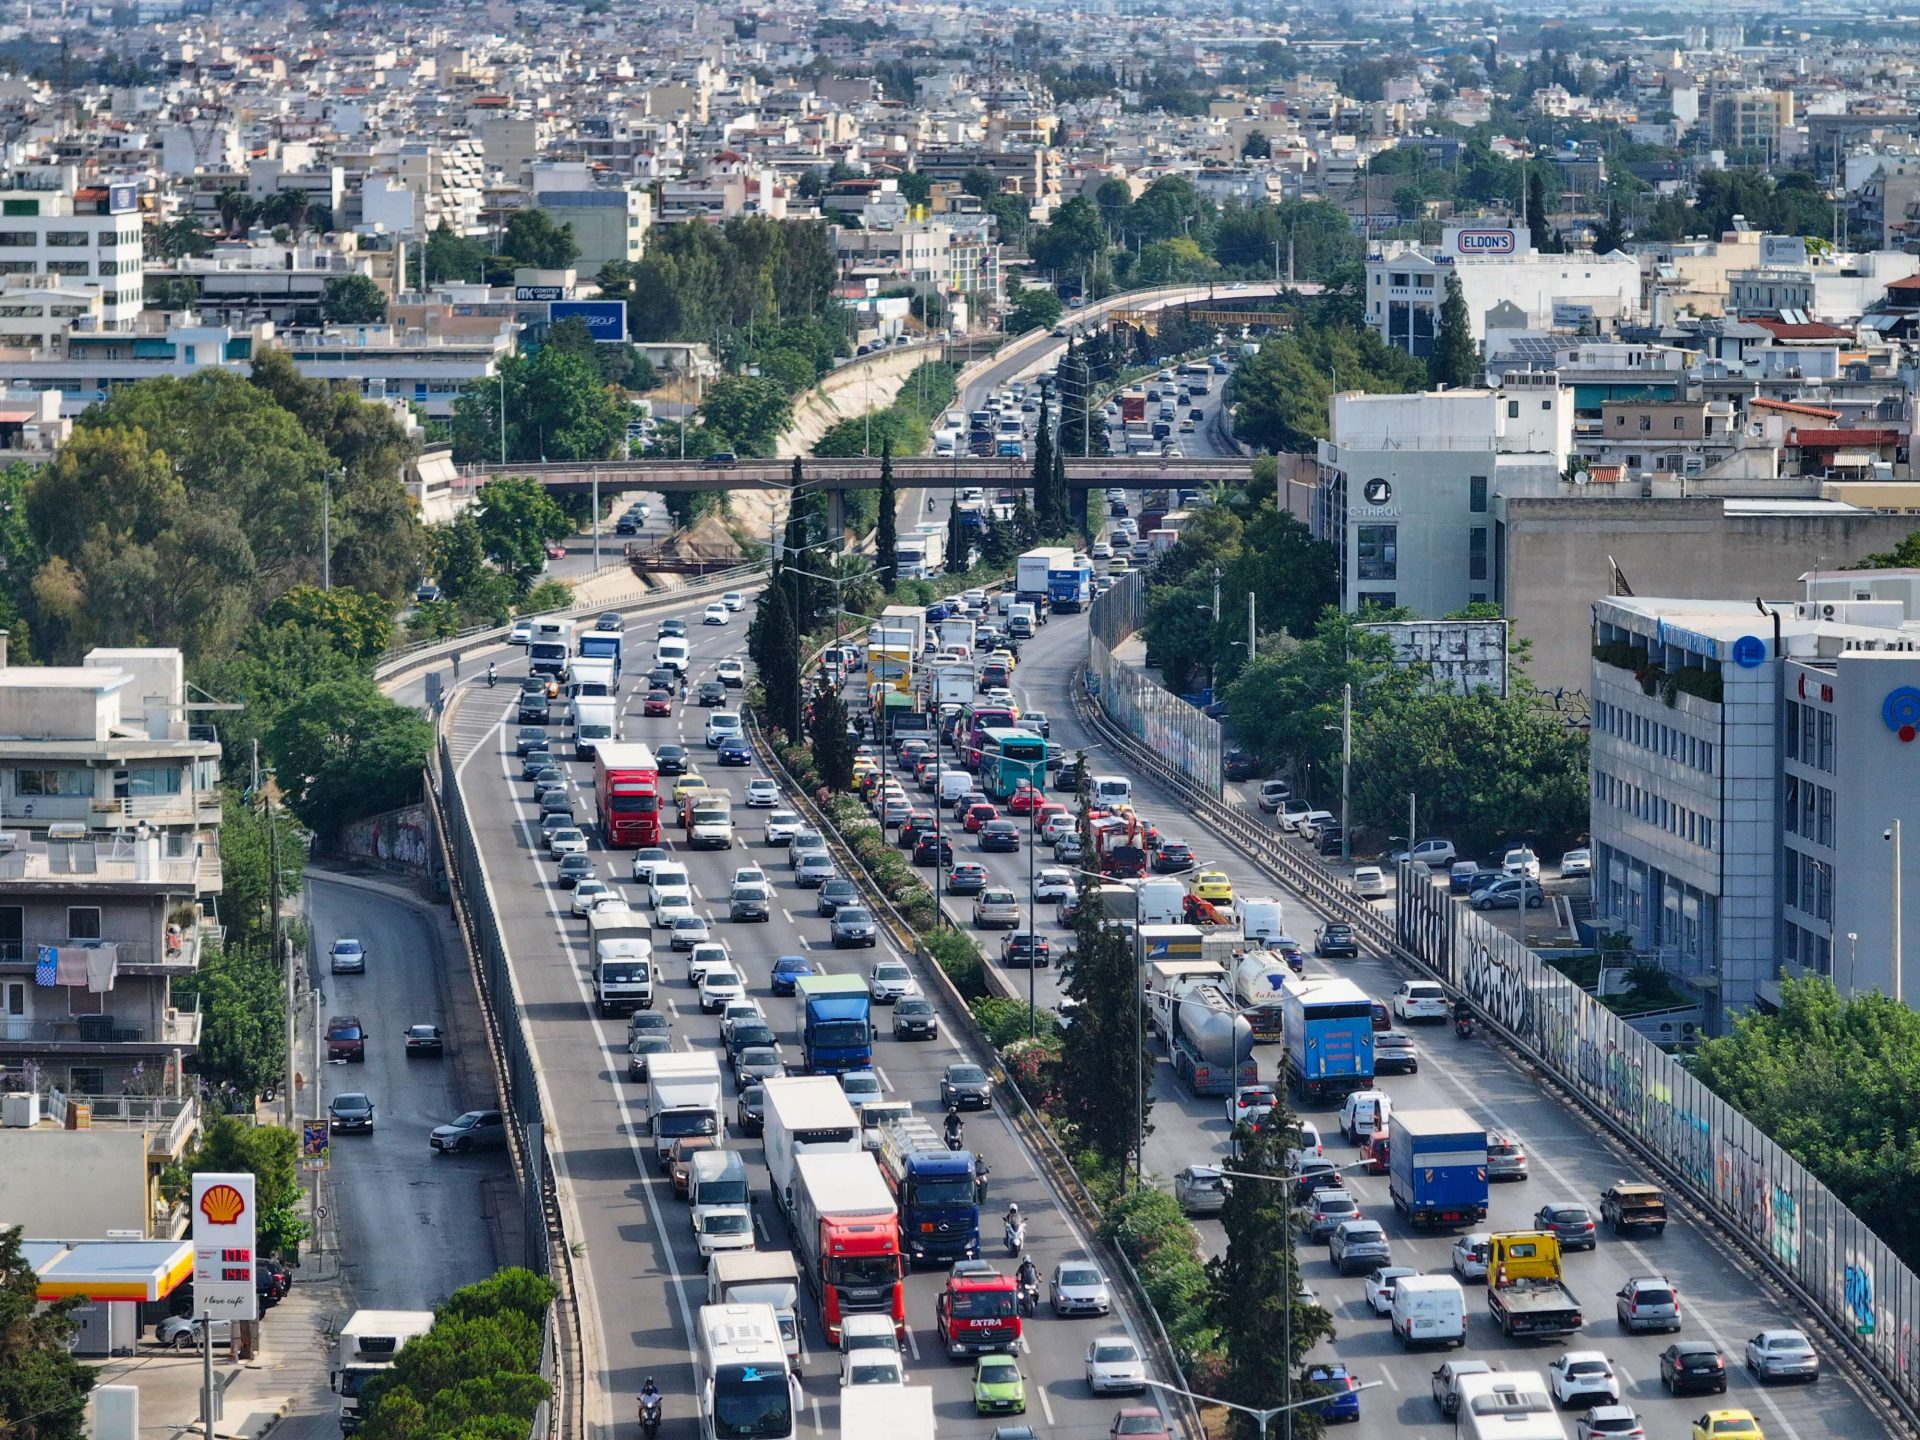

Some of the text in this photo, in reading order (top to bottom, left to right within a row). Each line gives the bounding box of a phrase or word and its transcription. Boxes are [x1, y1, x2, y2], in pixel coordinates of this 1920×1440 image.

[1464, 236, 1509, 248] ELDON'S
[209, 1296, 224, 1304] love
[227, 1296, 244, 1308] café
[970, 1319, 1002, 1327] EXTRA
